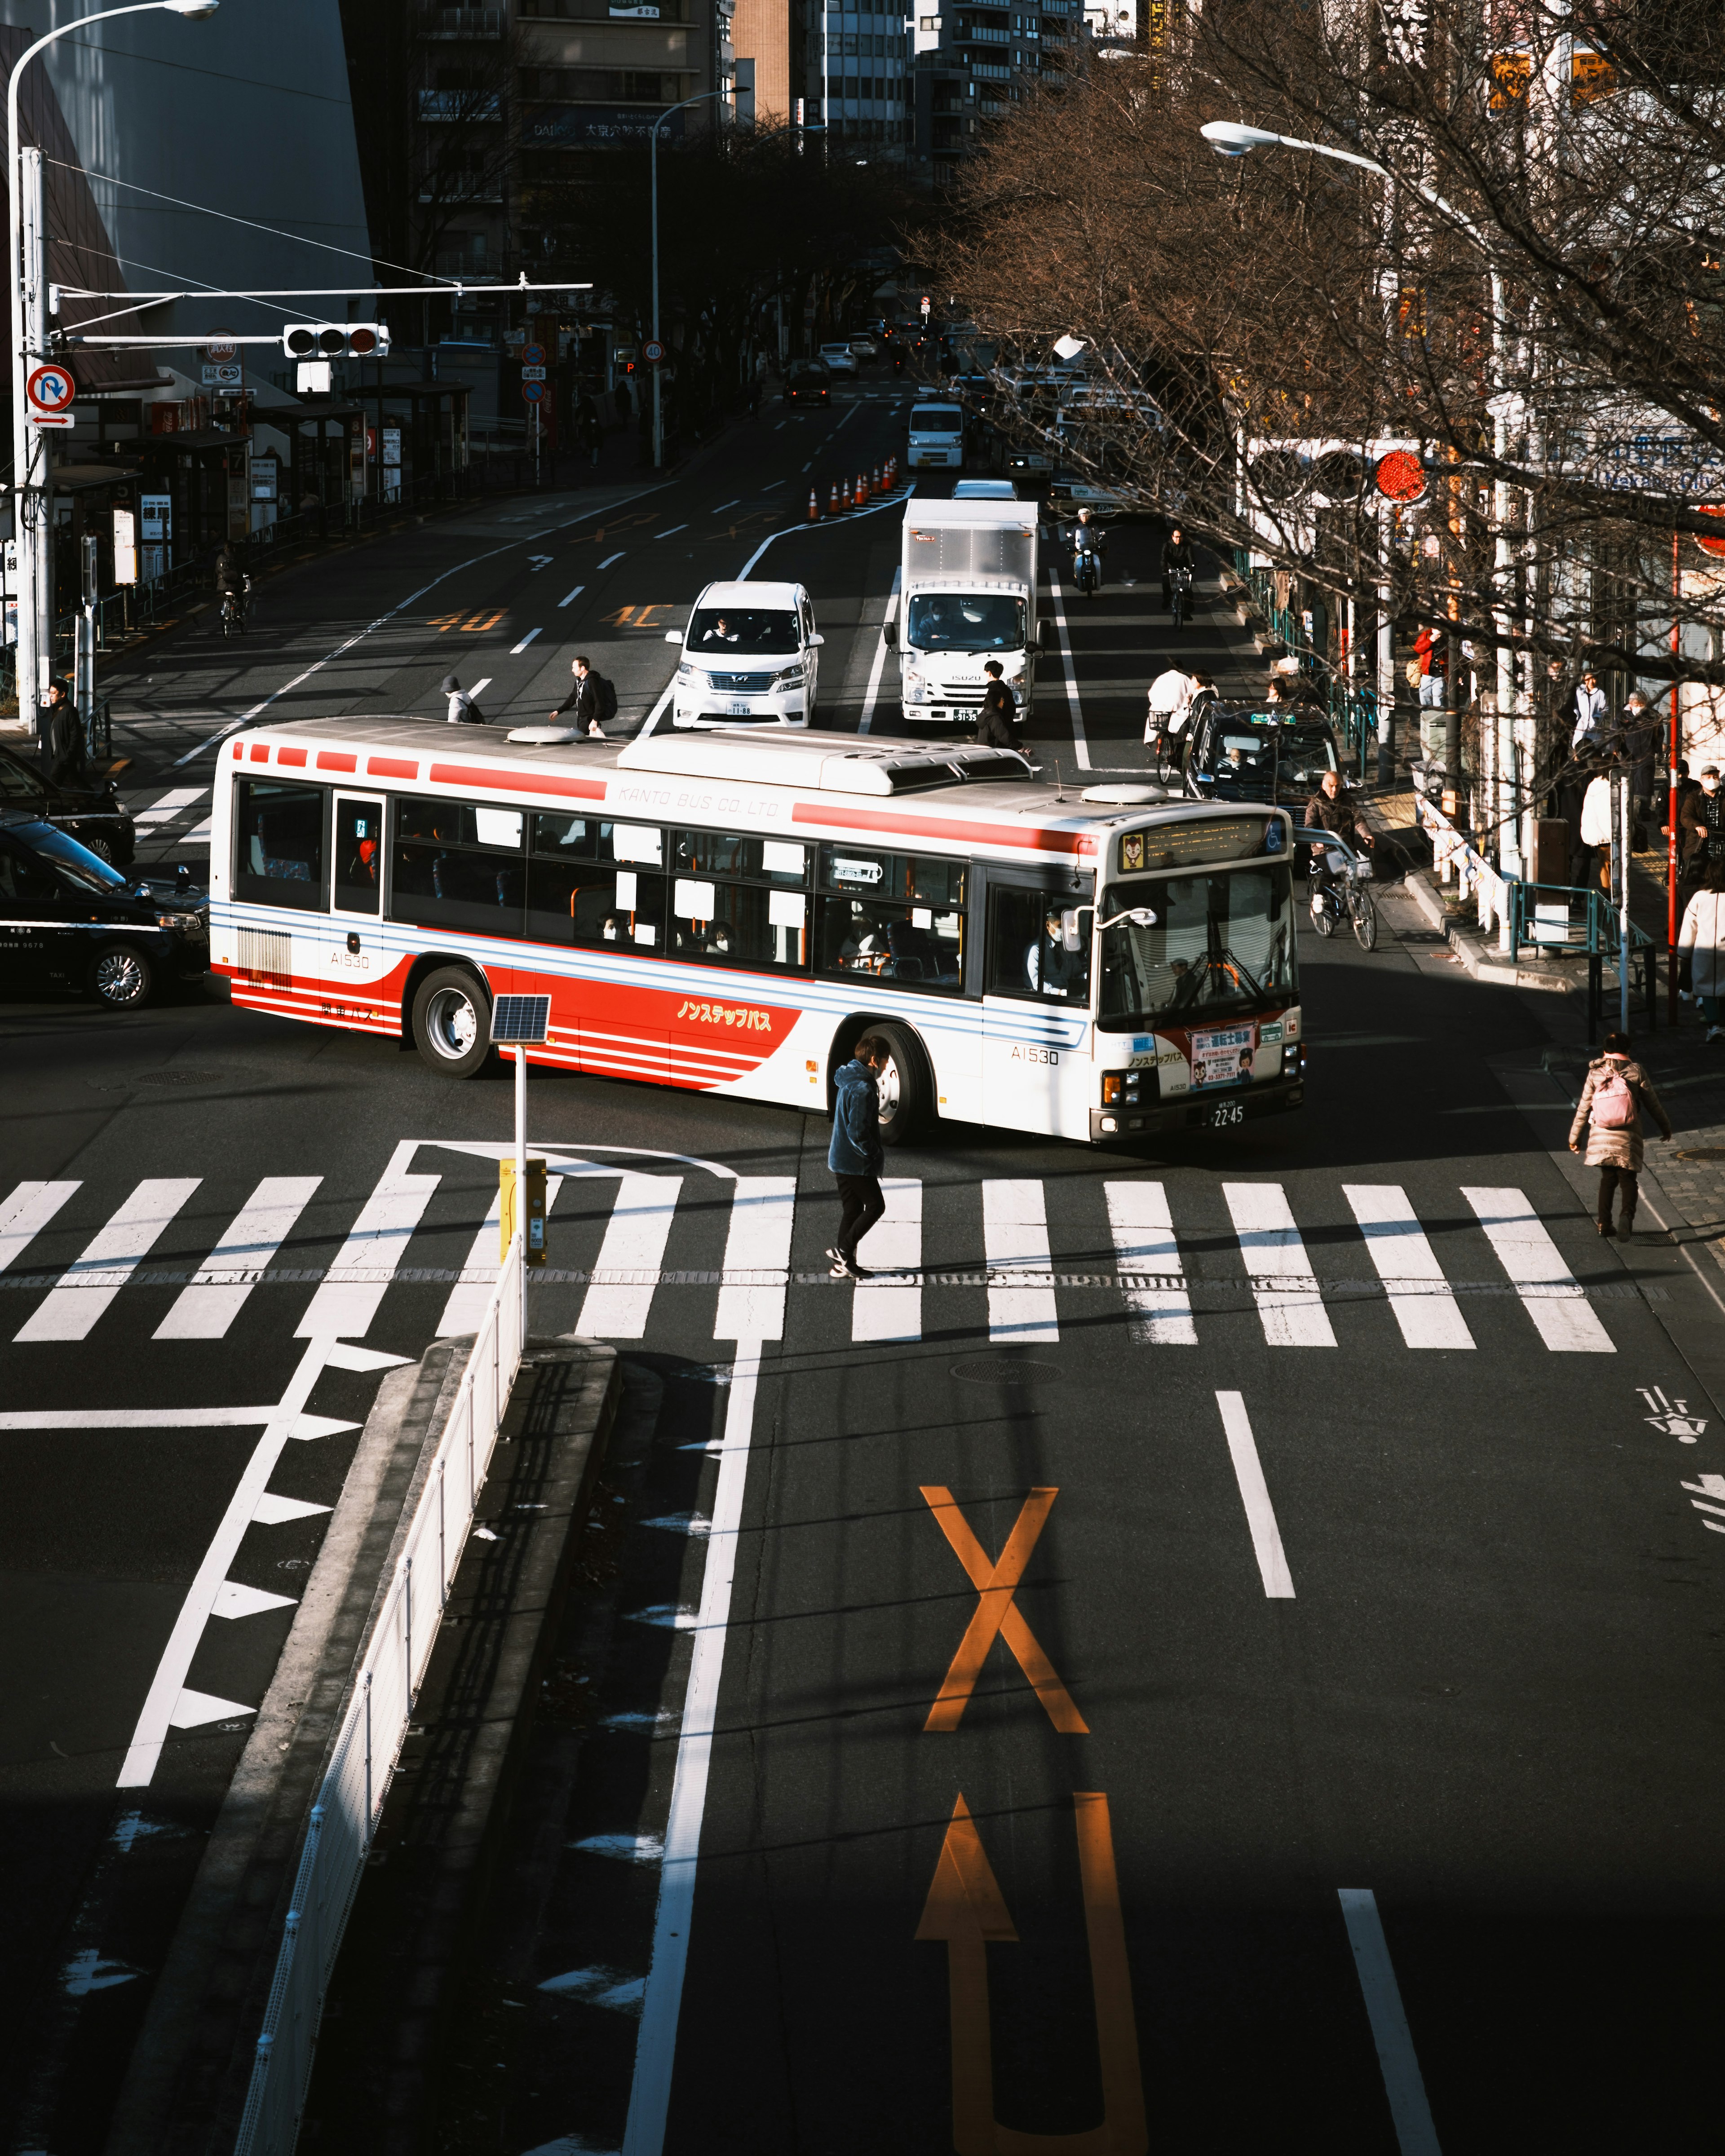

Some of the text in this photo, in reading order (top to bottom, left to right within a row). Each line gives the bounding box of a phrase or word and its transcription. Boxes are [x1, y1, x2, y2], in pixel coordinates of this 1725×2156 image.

[211, 344, 233, 353] 消火栓
[648, 347, 660, 356] 40
[628, 363, 634, 372] P
[352, 420, 359, 431] 8
[232, 455, 242, 468] 7
[117, 485, 128, 497] 5
[143, 507, 169, 520] 練馬
[426, 609, 510, 632] 40
[619, 787, 671, 804] KANTO
[677, 794, 712, 809] BUS
[322, 1003, 373, 1023] 関東バス
[677, 1001, 771, 1031] ノンステップバス
[1212, 1030, 1250, 1047] 運転士募集
[1128, 1052, 1183, 1067] ノンステップバス
[1208, 1072, 1235, 1081] 03-3371-7111
[1215, 1106, 1243, 1127] 22-45
